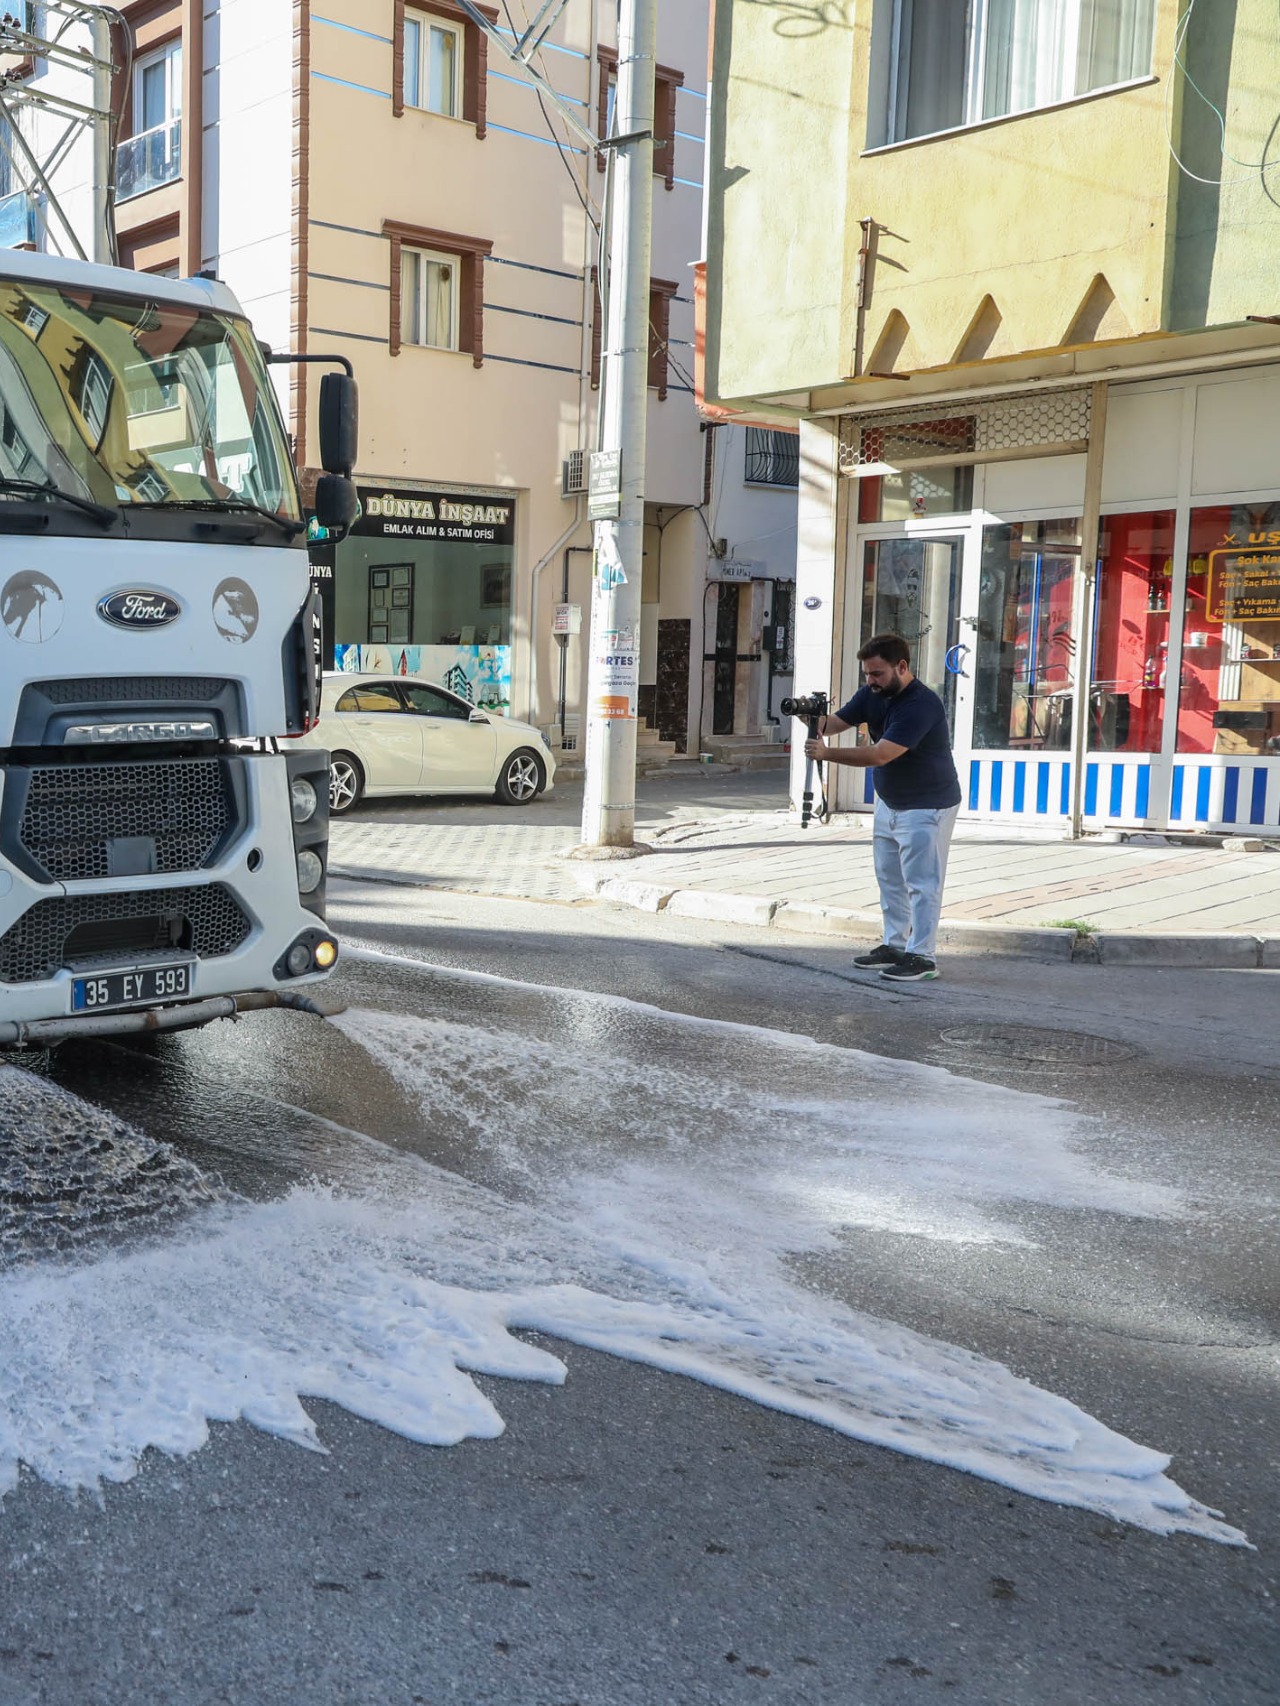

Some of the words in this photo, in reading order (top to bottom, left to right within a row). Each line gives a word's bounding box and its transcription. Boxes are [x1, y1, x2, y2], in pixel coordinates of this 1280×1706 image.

[365, 493, 436, 520] DÜNYA
[438, 497, 510, 526] İNŞAAT
[383, 523, 414, 535] EMLAK
[415, 525, 437, 536] ALIM
[438, 526, 445, 537] &
[447, 527, 473, 539] SATIM
[474, 528, 495, 540] OFİSİ
[1237, 556, 1259, 567] Şok
[309, 563, 333, 578] ÜNYA
[1243, 579, 1260, 588] Saç
[121, 594, 167, 619] Ford
[1238, 607, 1255, 616] Saç
[90, 723, 193, 743] CARGO
[86, 979, 109, 1006] 35
[123, 974, 144, 1000] EY
[155, 968, 186, 995] 593
